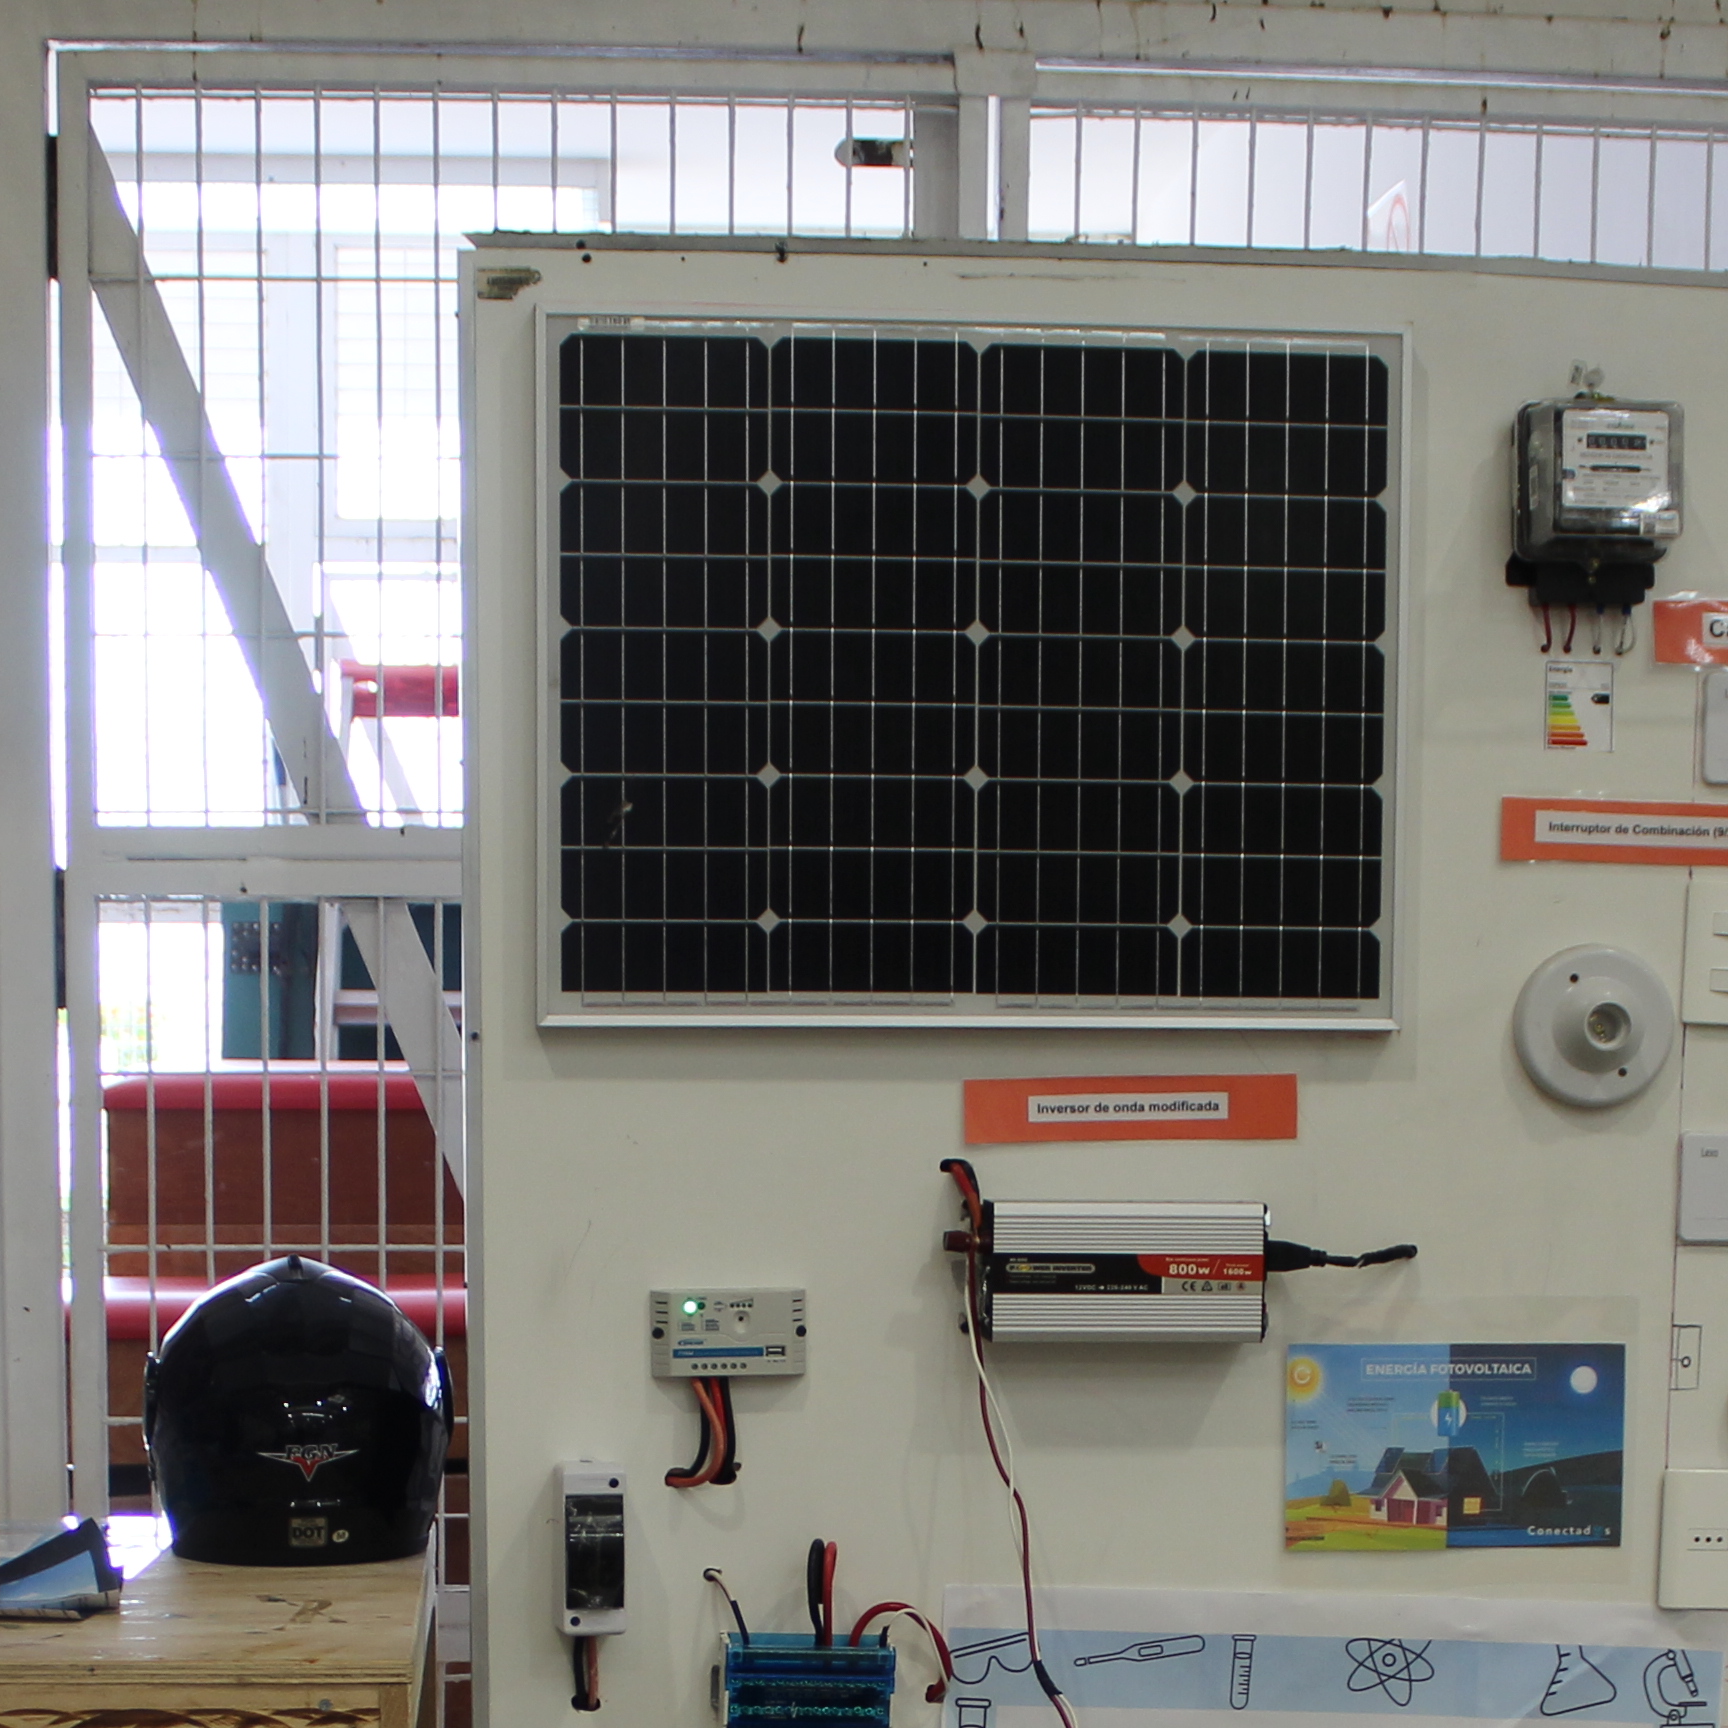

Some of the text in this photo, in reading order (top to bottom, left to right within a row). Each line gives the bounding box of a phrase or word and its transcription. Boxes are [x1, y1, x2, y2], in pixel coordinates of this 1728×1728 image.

[1547, 820, 1611, 838] Interruptor
[1615, 823, 1630, 836] de
[1633, 822, 1710, 840] Combinación
[1036, 1099, 1220, 1115] Inversor de onda modificada
[1365, 1361, 1533, 1376] ENERGÍA FOTOVOLTAICA
[292, 1526, 324, 1539] DOT
